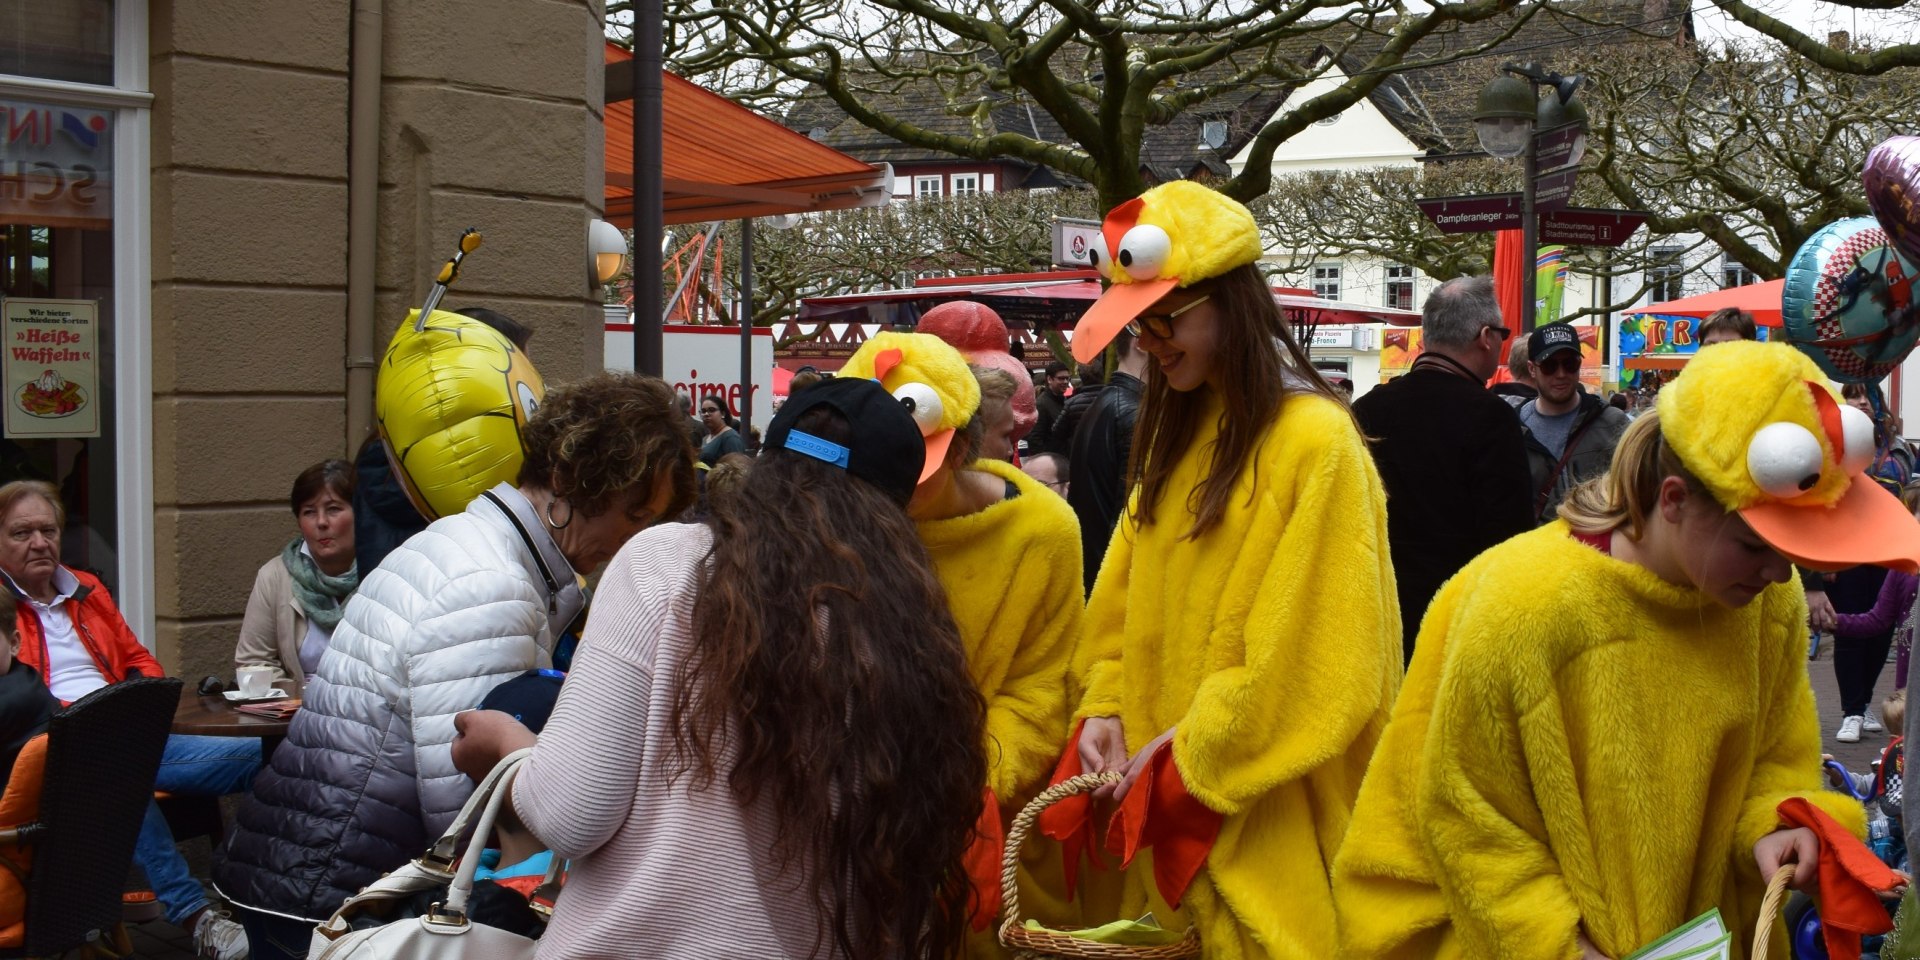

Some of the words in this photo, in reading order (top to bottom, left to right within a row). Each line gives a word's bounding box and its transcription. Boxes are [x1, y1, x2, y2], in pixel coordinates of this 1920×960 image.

[1436, 212, 1502, 224] Dampferanleger
[1545, 220, 1595, 231] Stadttourismus
[1545, 230, 1596, 241] Stadtmarketing
[28, 308, 45, 317] Wir
[46, 309, 71, 317] bieten
[62, 317, 89, 325] Sorten
[1650, 320, 1700, 346] TR
